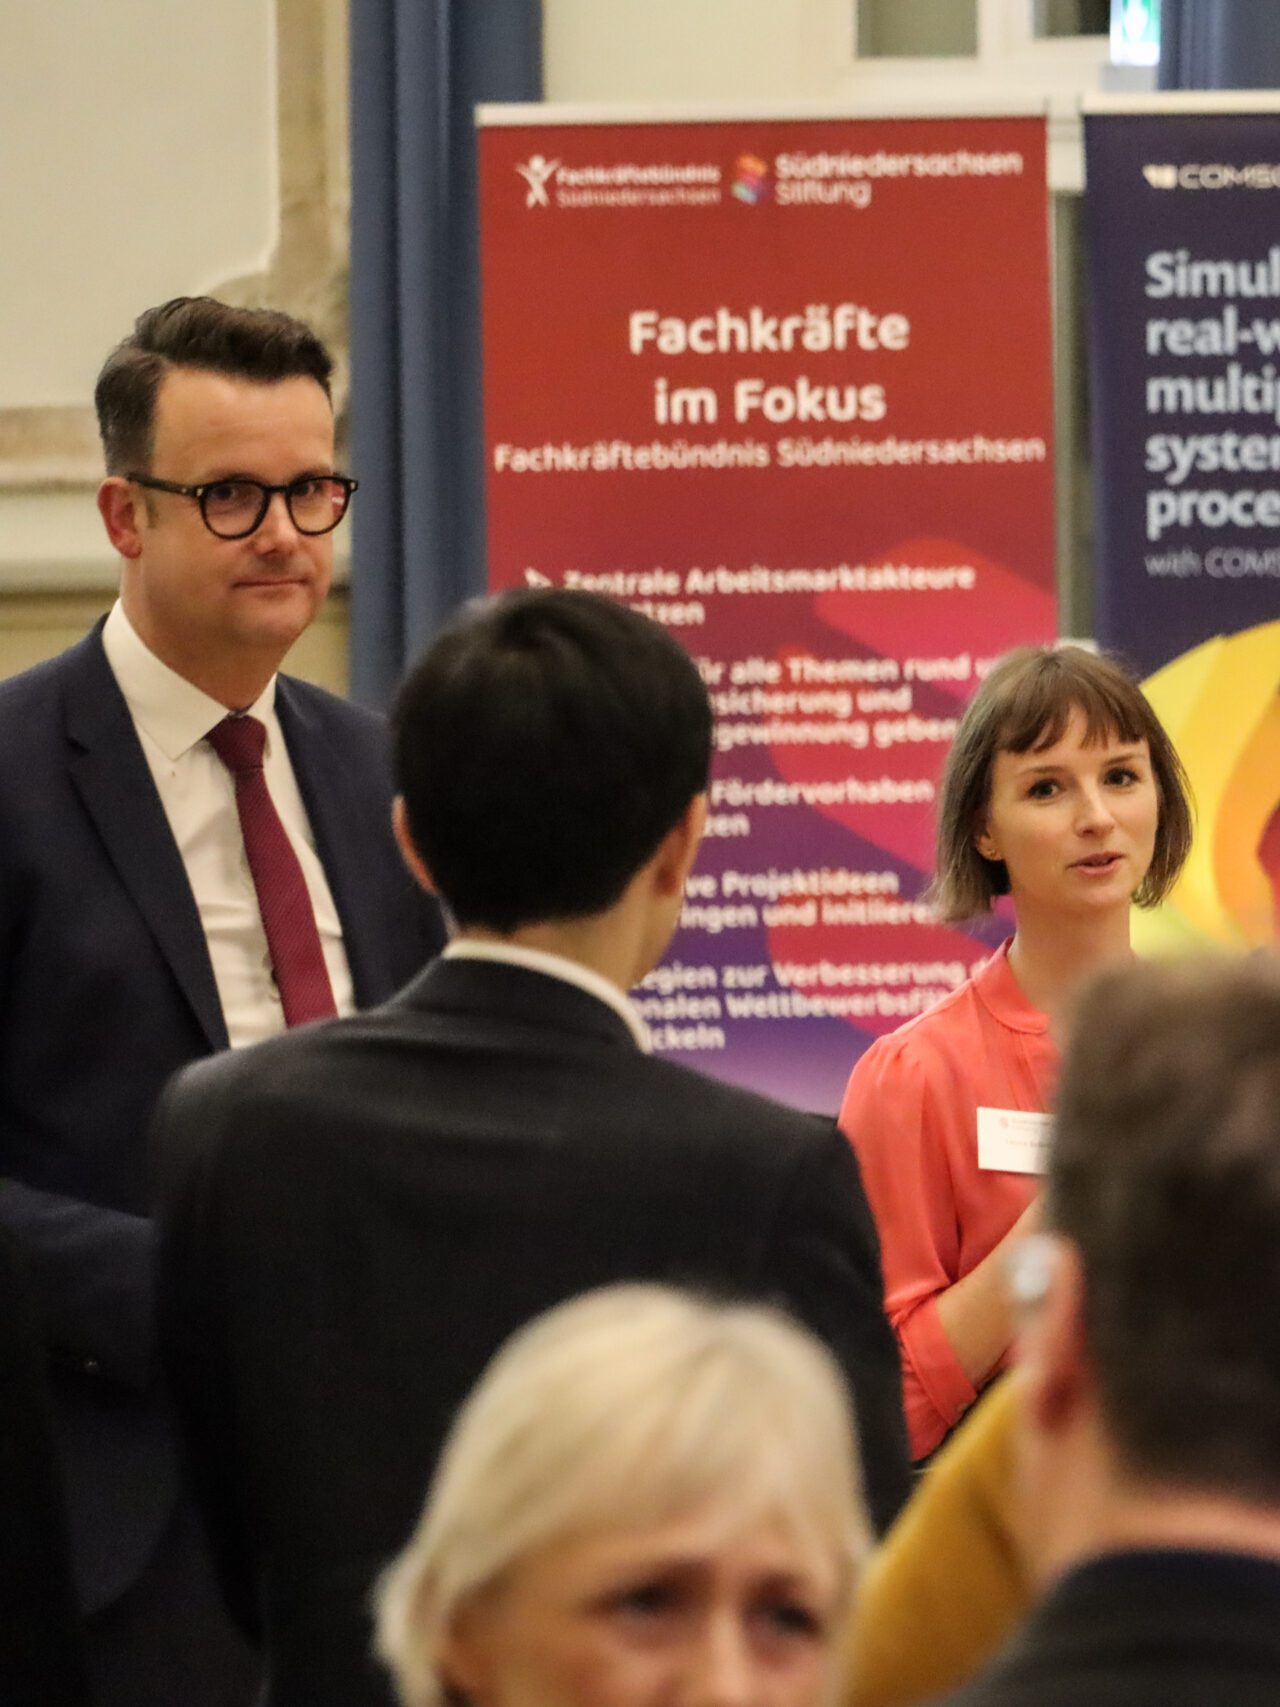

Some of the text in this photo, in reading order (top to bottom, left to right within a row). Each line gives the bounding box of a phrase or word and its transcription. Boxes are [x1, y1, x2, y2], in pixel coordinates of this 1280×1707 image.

[776, 152, 1023, 181] Südniedersachsen
[776, 181, 871, 207] Stiftung
[629, 303, 911, 355] Fachkräfte
[655, 376, 887, 425] im Fokus
[494, 434, 1047, 474] Fachkräftebündnis Südniedersachsen
[686, 564, 977, 595] Arbeitsmarktakteure
[1145, 547, 1200, 578] with
[730, 656, 781, 685] alle
[786, 657, 899, 683] Themen
[903, 652, 971, 681] rund
[709, 684, 913, 719] sicherung und
[712, 717, 869, 751] gewinnung
[721, 868, 899, 902] Projektideen
[680, 901, 758, 934] ingen
[763, 899, 818, 926] und
[633, 960, 718, 995] egien
[722, 965, 770, 989] zur
[773, 962, 966, 992] Verbesserung
